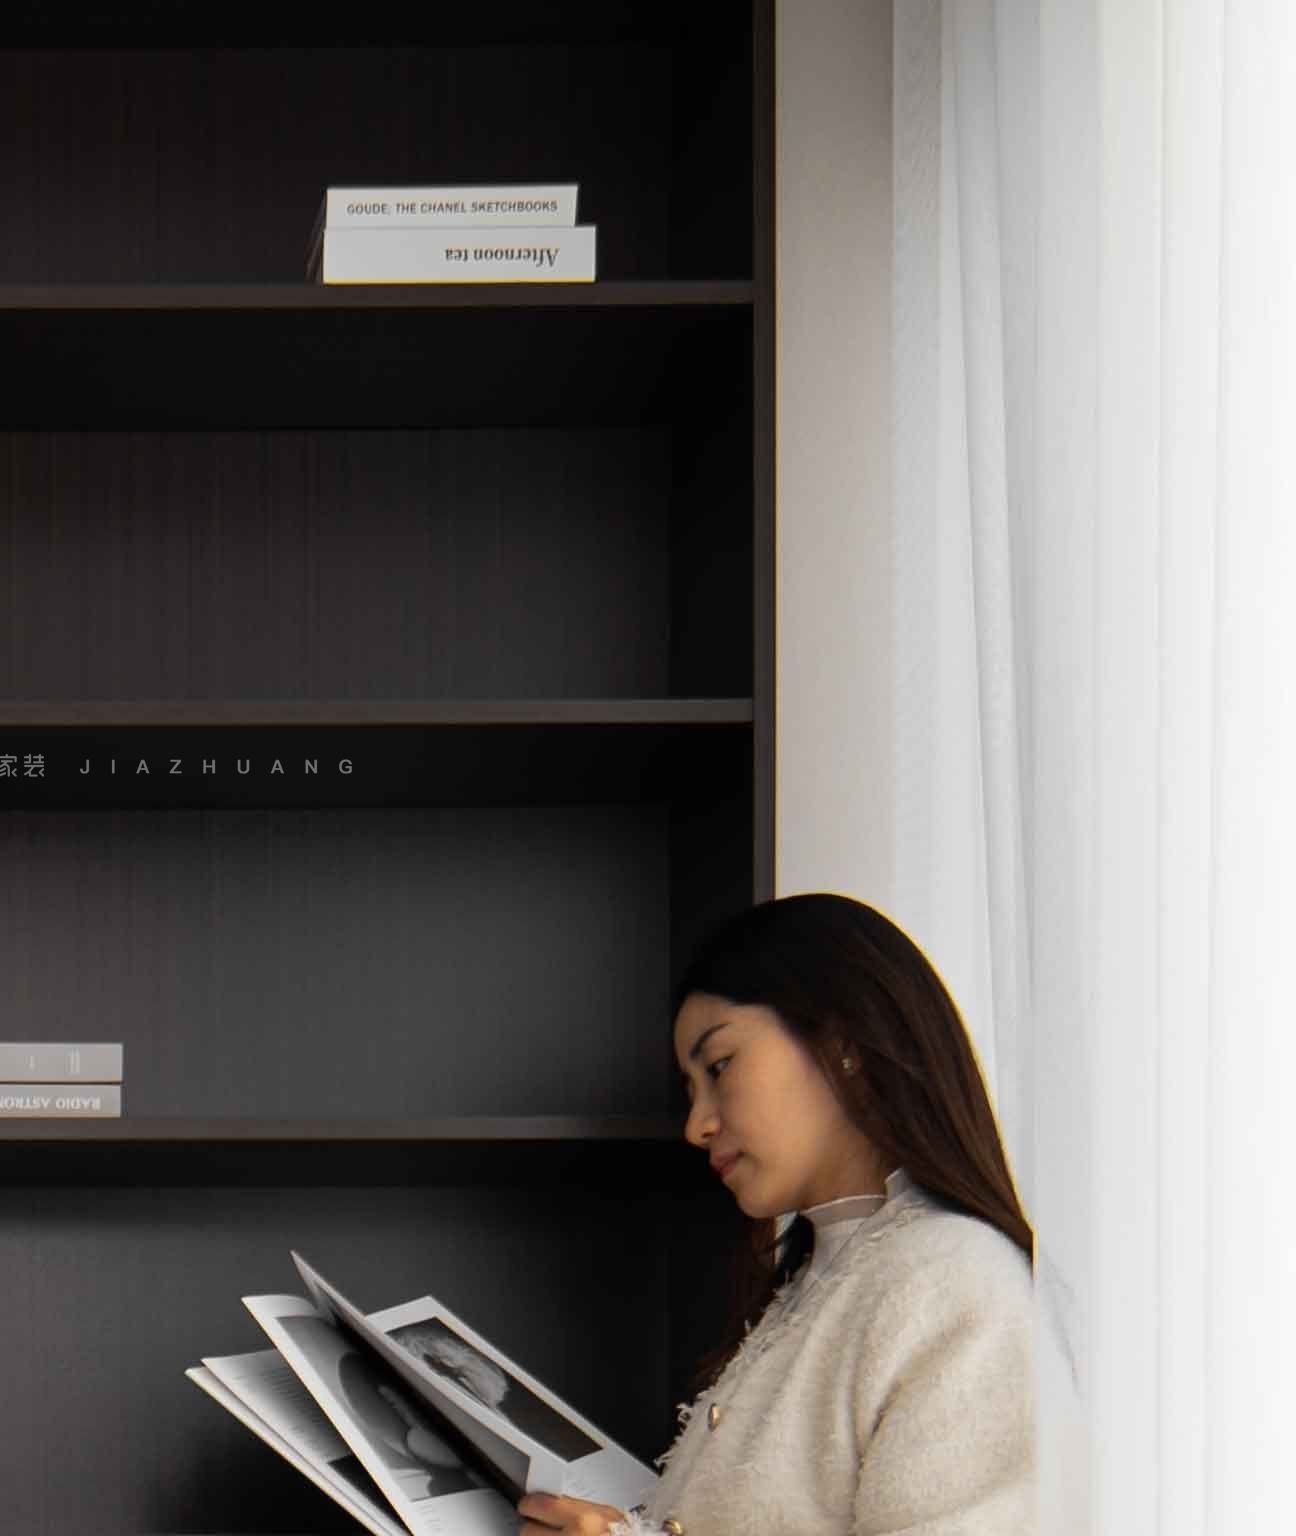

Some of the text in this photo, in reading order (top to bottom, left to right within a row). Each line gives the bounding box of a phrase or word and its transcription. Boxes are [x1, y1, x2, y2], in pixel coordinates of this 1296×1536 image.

[346, 200, 558, 216] GOUDE: THE CHANEL SKETCHBOOKS
[445, 248, 560, 267] Afternoon tea
[55, 1097, 101, 1111] RADIO
